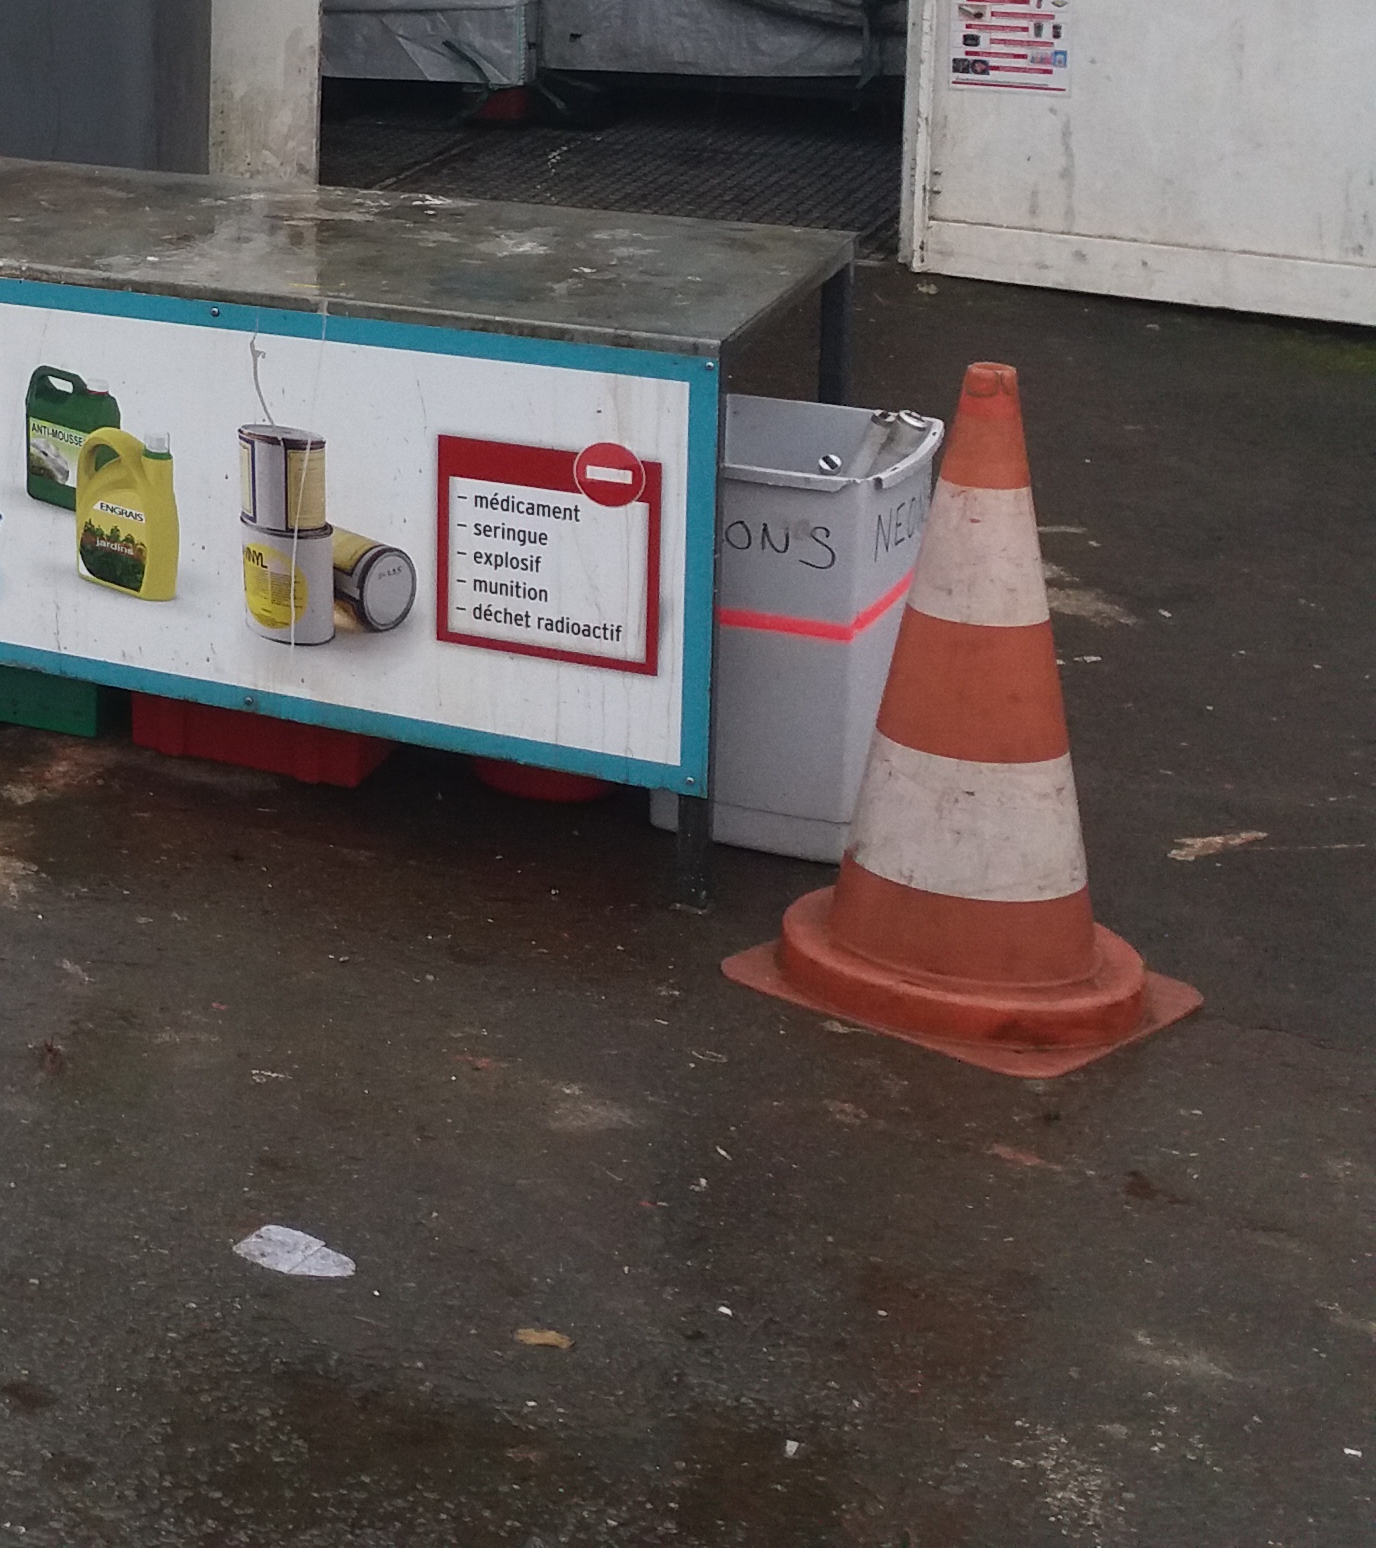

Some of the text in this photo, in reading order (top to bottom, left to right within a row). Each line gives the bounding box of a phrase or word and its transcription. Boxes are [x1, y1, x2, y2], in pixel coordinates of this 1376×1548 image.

[100, 502, 144, 522] ENGRAIS
[474, 493, 580, 522] médicament
[474, 522, 548, 546] seringue
[725, 520, 836, 569] ONS
[473, 550, 541, 572] explosif
[473, 577, 548, 602] munition
[473, 603, 623, 642] déchet radioactif
